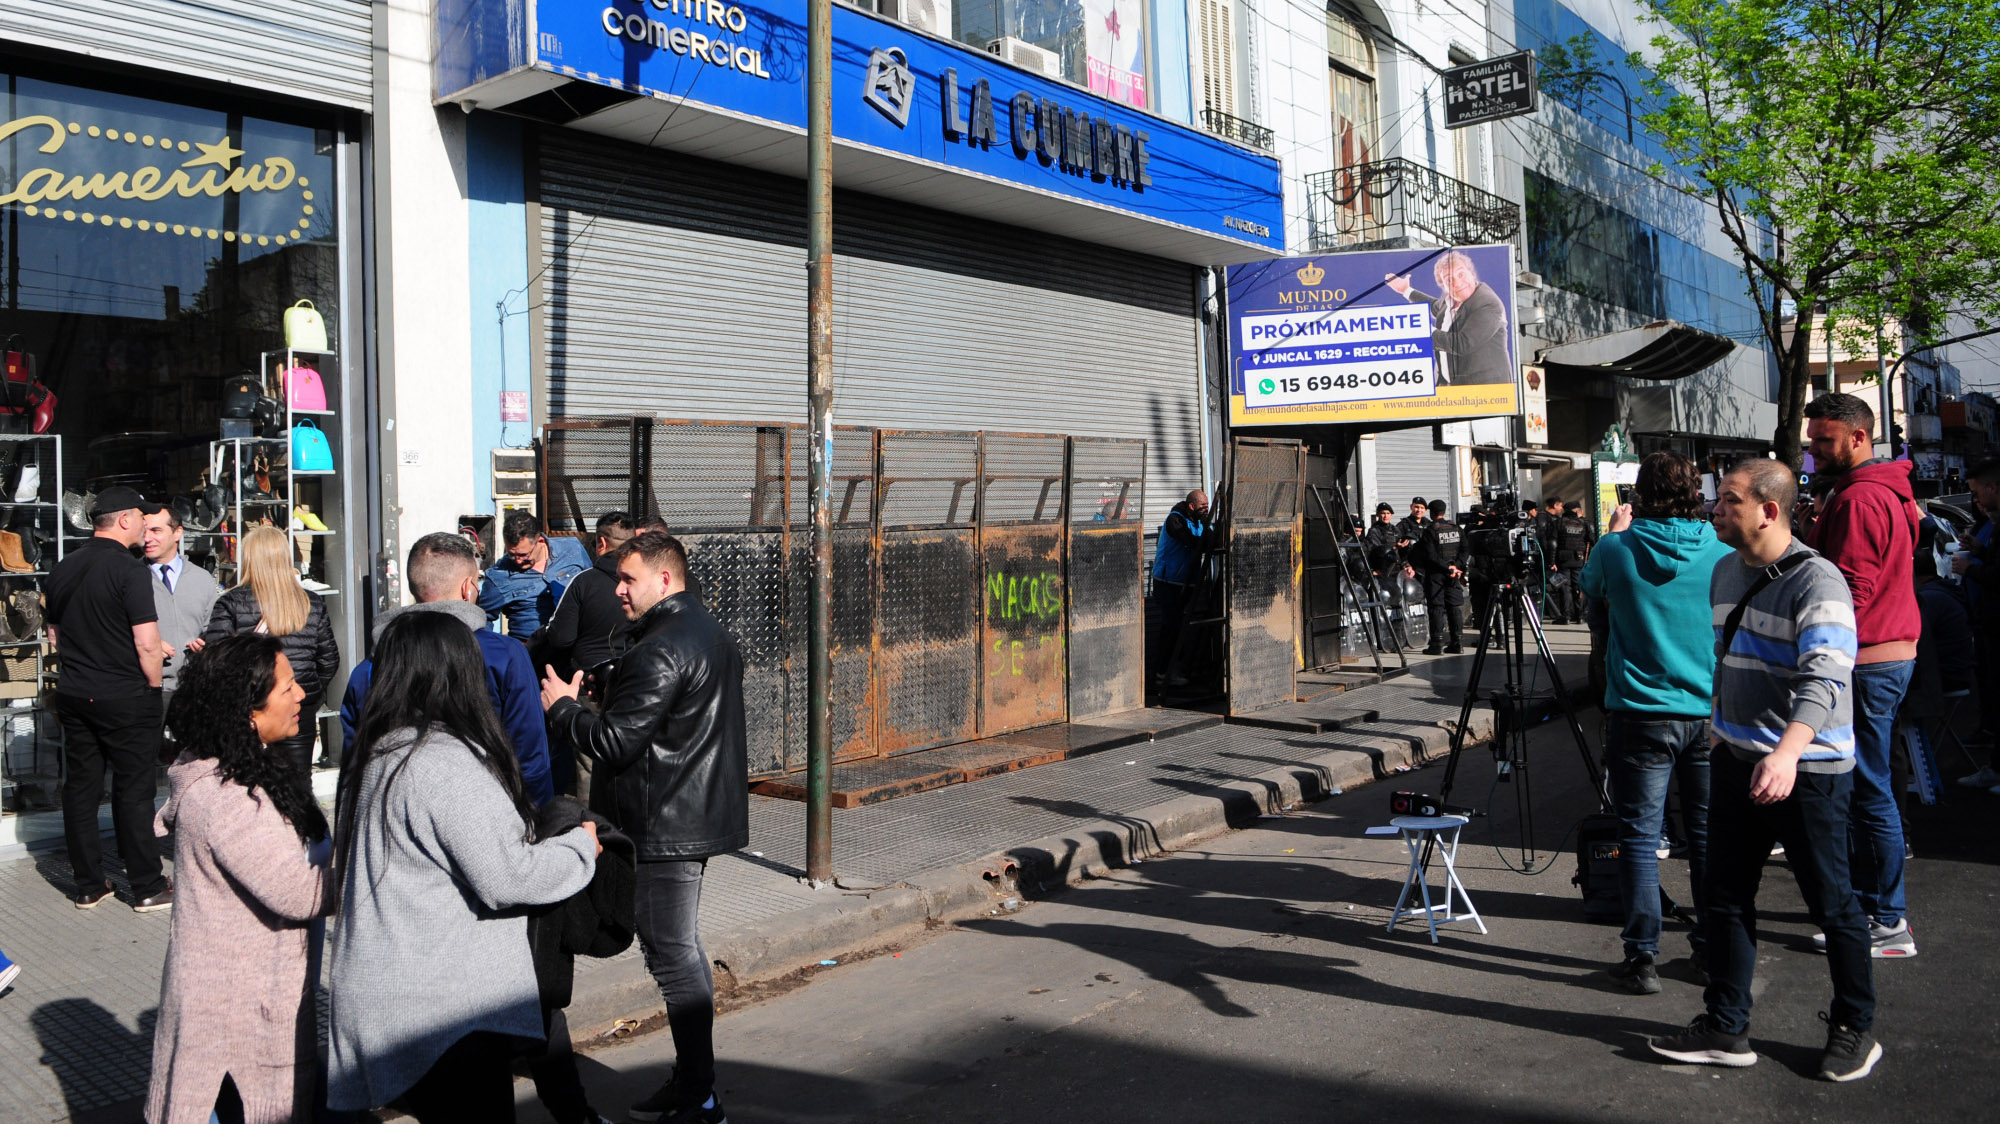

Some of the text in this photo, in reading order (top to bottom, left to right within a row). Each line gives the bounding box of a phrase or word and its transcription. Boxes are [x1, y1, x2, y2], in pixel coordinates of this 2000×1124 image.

[1463, 61, 1512, 80] FAMILIAR
[1448, 71, 1527, 105] HOTEL
[940, 67, 1152, 193] LA CUMBRE
[1278, 288, 1347, 305] MUNDO
[1251, 313, 1422, 340] PRÓXIMAMENTE
[1262, 351, 1312, 364] JUNCAL
[1314, 348, 1343, 360] 1629
[1353, 343, 1423, 358] RECOLETA.
[1280, 369, 1424, 393] 15 6948-0046
[1383, 395, 1509, 409] www.mundodelasalhajas.com
[990, 638, 1024, 677] SE
